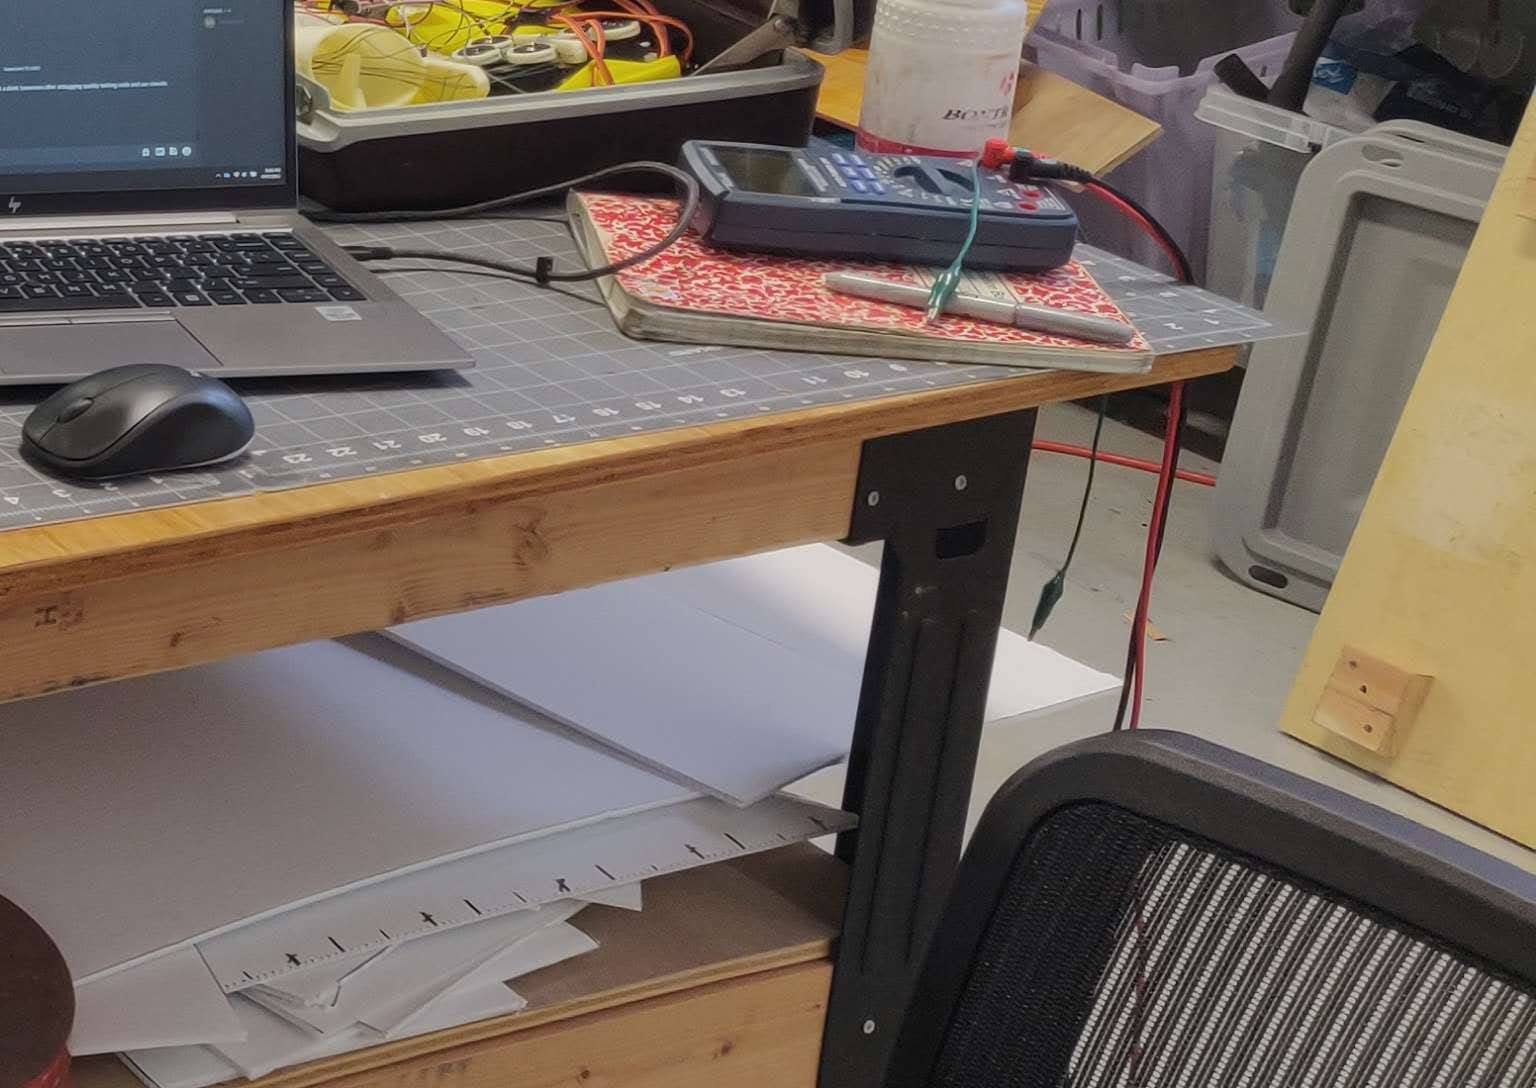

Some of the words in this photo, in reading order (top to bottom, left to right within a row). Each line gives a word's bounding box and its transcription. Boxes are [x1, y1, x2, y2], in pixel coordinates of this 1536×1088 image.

[326, 446, 358, 458] 22
[371, 439, 403, 451] 21
[418, 432, 448, 444] 20
[463, 426, 491, 437] 19
[506, 420, 533, 430] 18
[552, 413, 577, 424] 17
[3, 495, 22, 507] 4
[51, 488, 72, 499] 3
